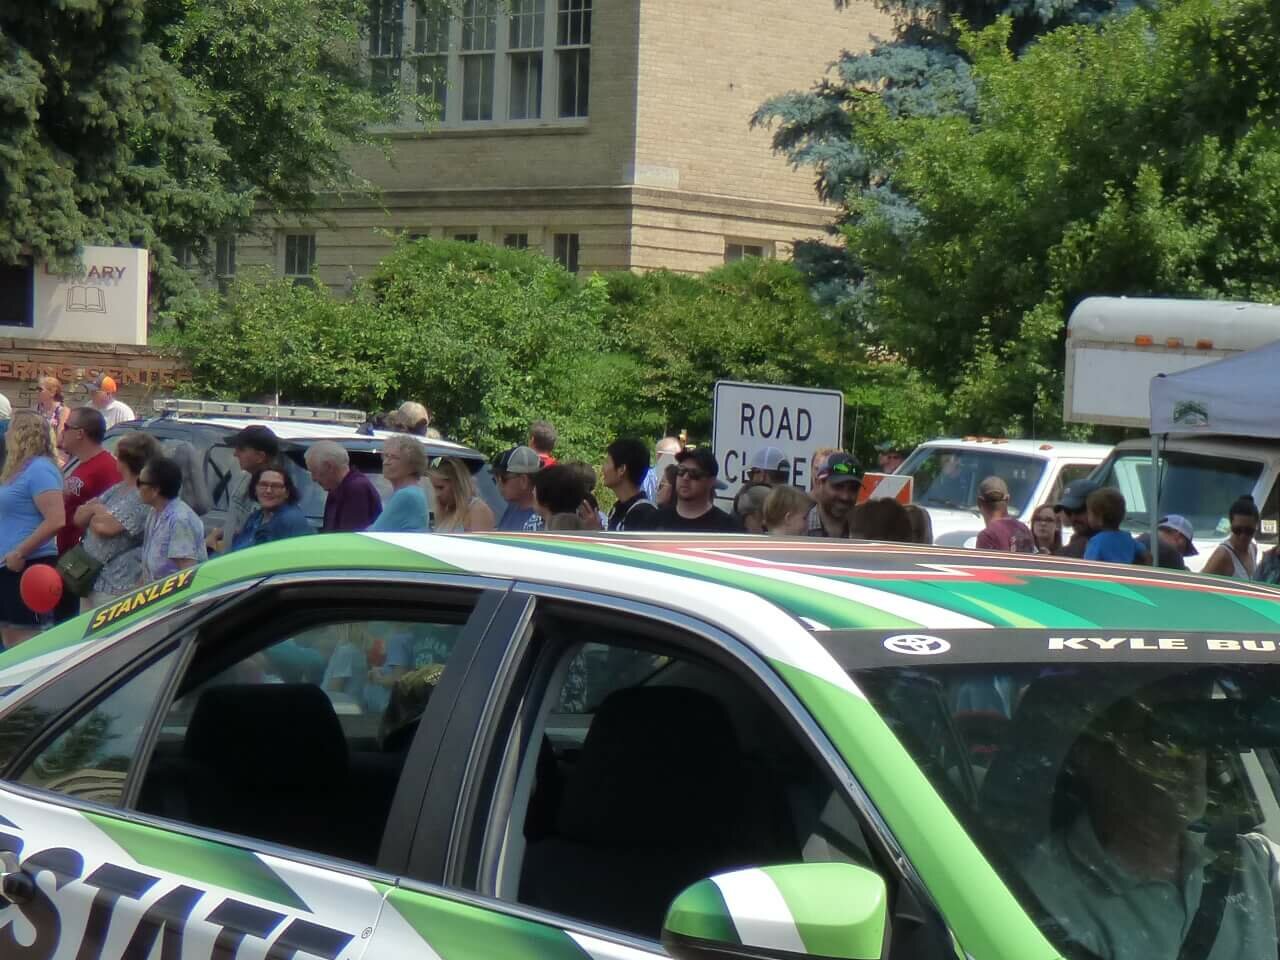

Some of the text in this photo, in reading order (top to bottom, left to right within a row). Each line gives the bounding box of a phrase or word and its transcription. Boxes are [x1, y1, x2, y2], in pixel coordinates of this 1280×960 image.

[740, 402, 813, 442] ROAD
[92, 570, 192, 629] STANLEY
[1048, 637, 1188, 651] KYLE
